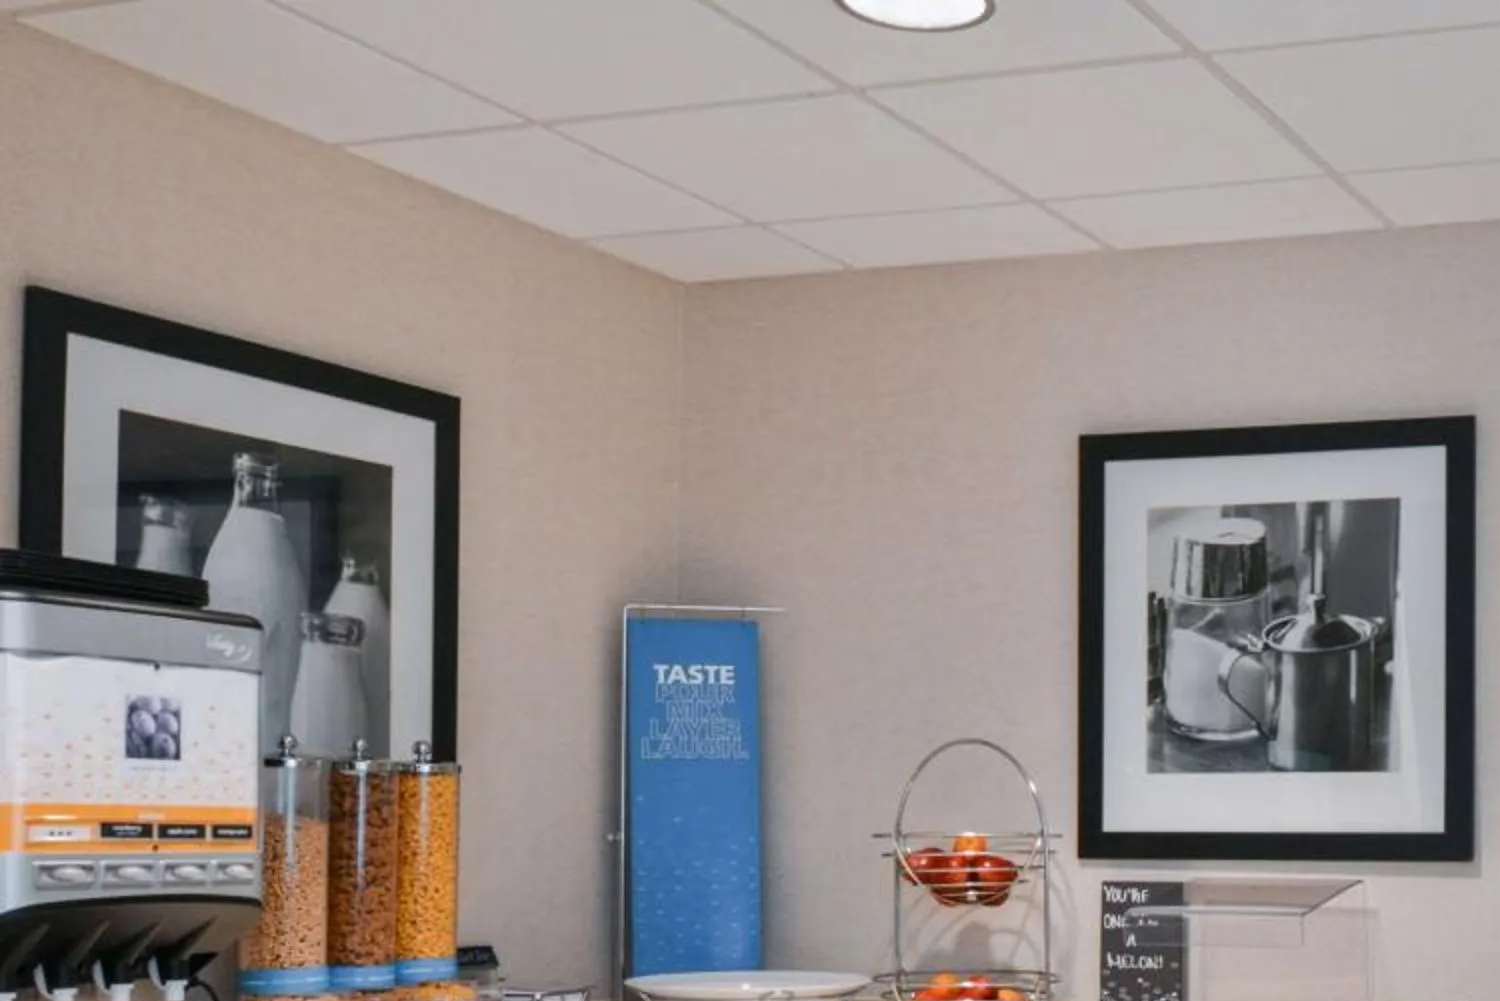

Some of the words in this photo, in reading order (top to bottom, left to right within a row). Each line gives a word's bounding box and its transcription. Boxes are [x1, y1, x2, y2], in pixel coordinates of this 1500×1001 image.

[652, 664, 736, 684] TASTE
[666, 699, 725, 721] MIX
[649, 718, 741, 741] LAYER
[1126, 933, 1137, 948] A
